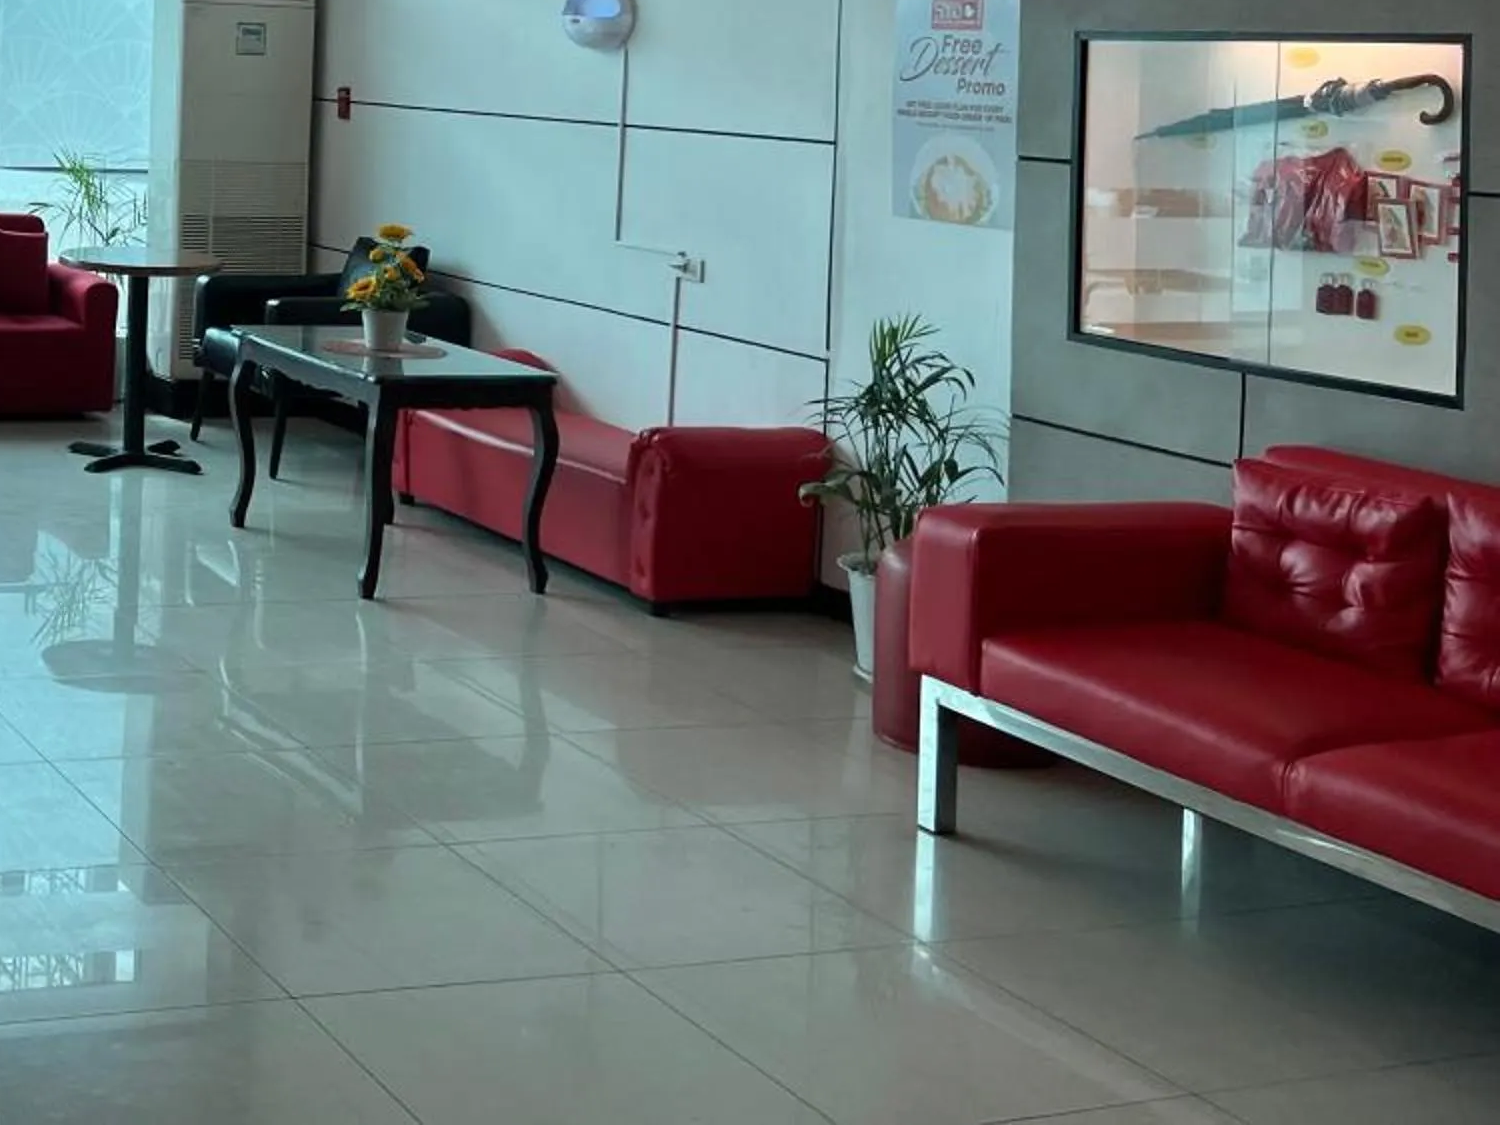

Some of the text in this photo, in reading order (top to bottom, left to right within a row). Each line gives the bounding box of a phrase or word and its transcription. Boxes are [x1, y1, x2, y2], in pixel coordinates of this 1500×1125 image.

[941, 35, 983, 55] Free
[900, 36, 1011, 81] Dessert
[956, 78, 1006, 97] Promo
